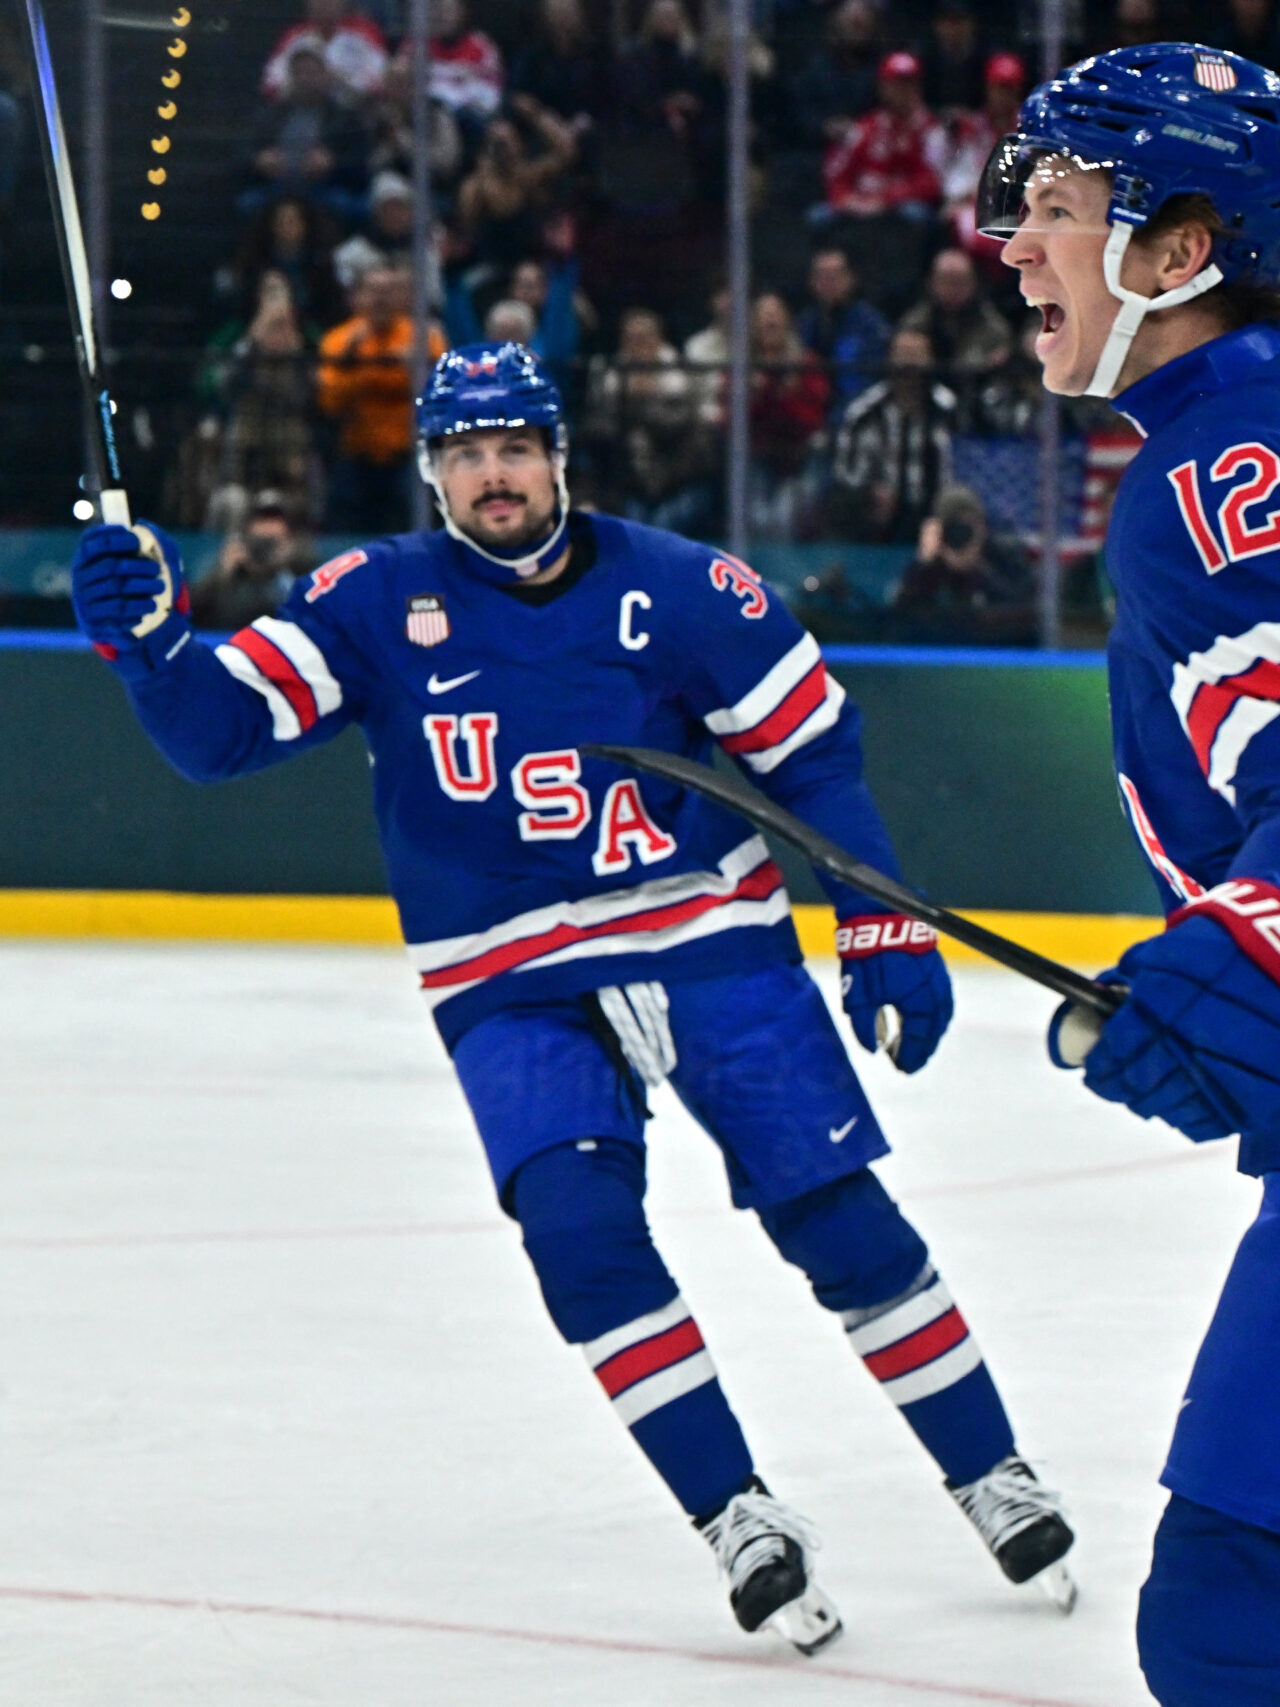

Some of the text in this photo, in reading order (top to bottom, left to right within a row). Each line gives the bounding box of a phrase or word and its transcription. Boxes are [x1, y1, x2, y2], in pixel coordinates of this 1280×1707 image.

[708, 548, 773, 620] 3
[618, 590, 652, 651] C
[423, 711, 677, 876] USA
